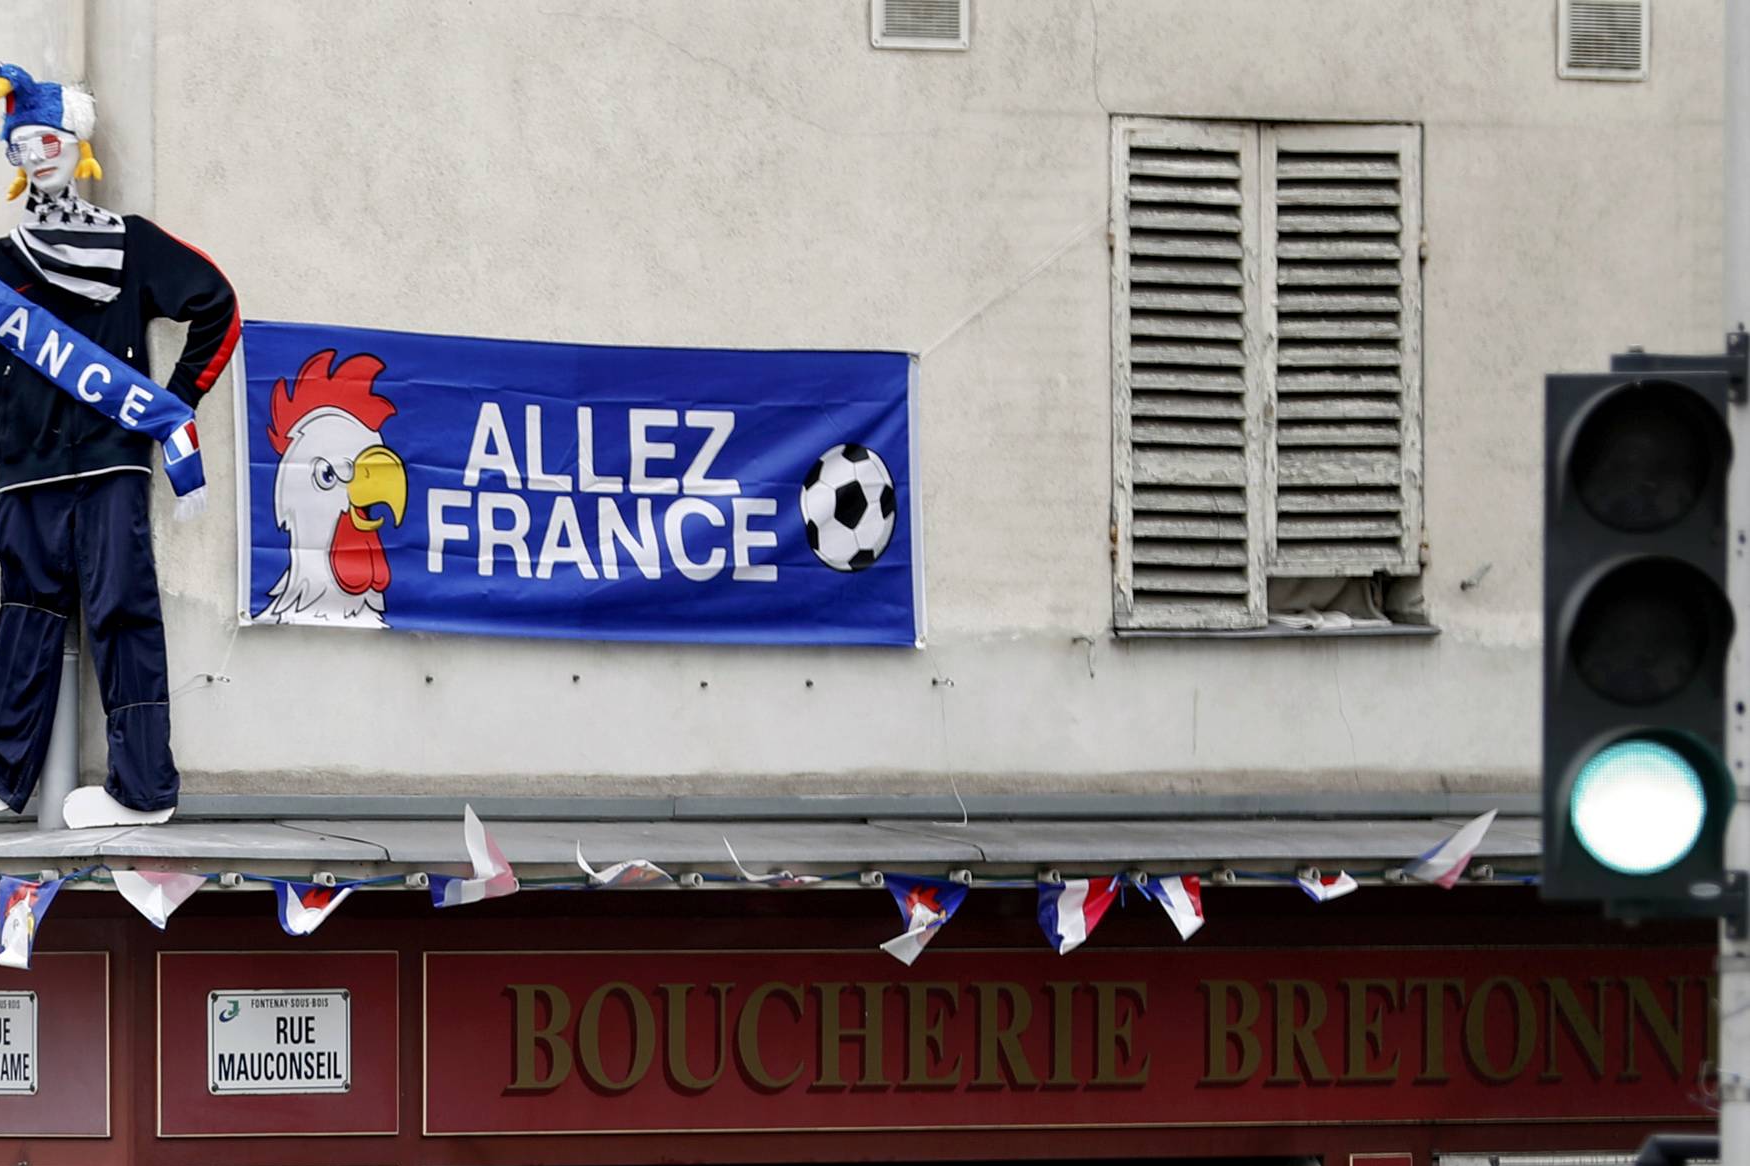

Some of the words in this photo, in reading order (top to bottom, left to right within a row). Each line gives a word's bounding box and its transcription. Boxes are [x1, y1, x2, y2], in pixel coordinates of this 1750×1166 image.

[463, 401, 741, 496] ALLEZ
[426, 488, 777, 582] FRANCE
[218, 1051, 342, 1081] MAUCONSEIL
[276, 1016, 316, 1045] RUE
[501, 981, 1150, 1097] BOUCHERIE
